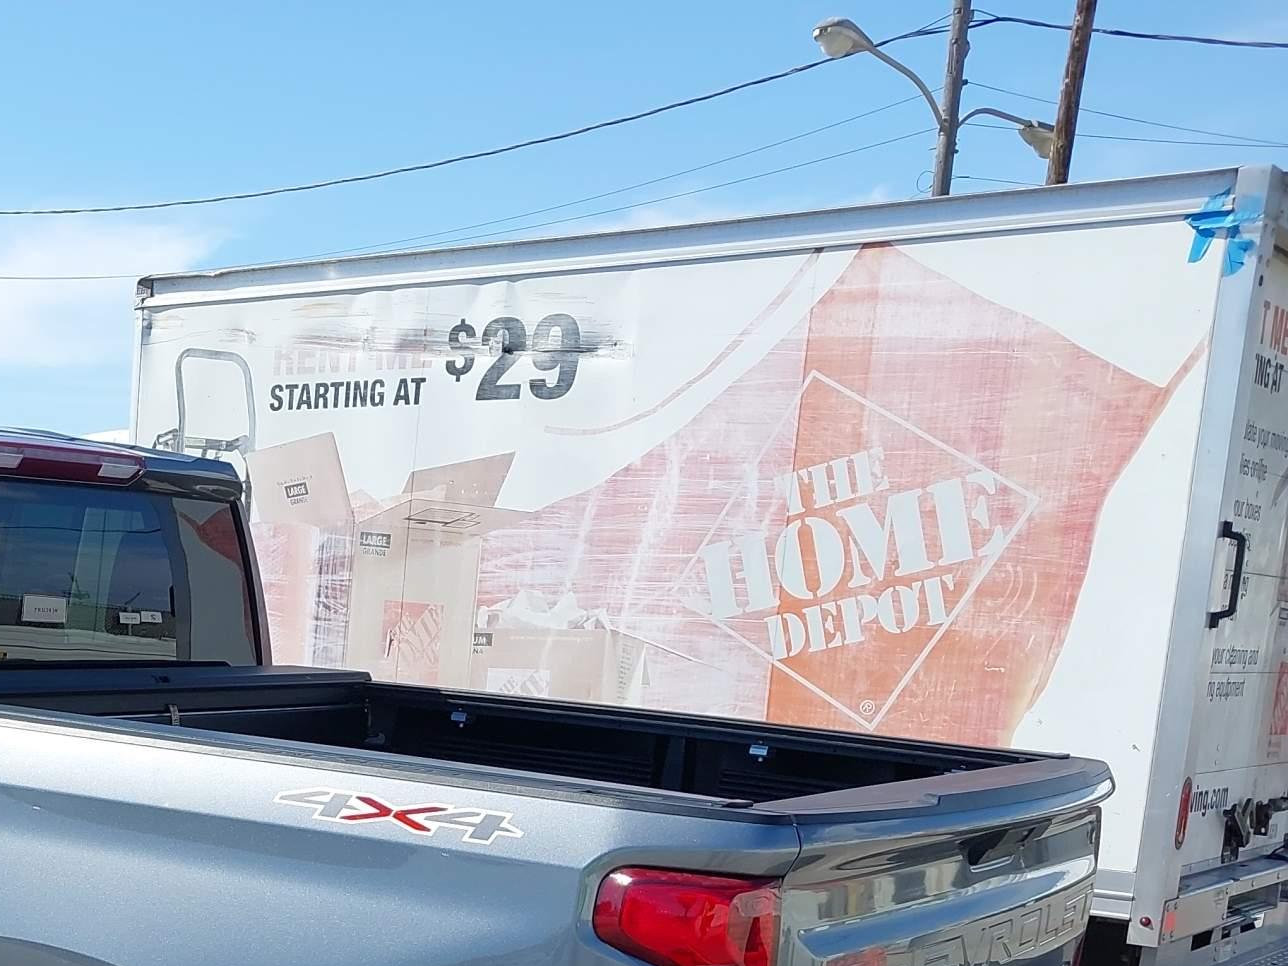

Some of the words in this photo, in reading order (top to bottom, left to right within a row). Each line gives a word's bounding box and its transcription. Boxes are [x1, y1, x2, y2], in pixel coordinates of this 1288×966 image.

[445, 313, 581, 401] $29
[269, 378, 386, 412] STARTING
[392, 377, 427, 406] AT
[286, 484, 308, 498] LARGE
[776, 448, 889, 516] THE
[363, 534, 388, 546] LARGE
[698, 469, 1011, 622] HOME
[764, 573, 955, 661] DEPOT
